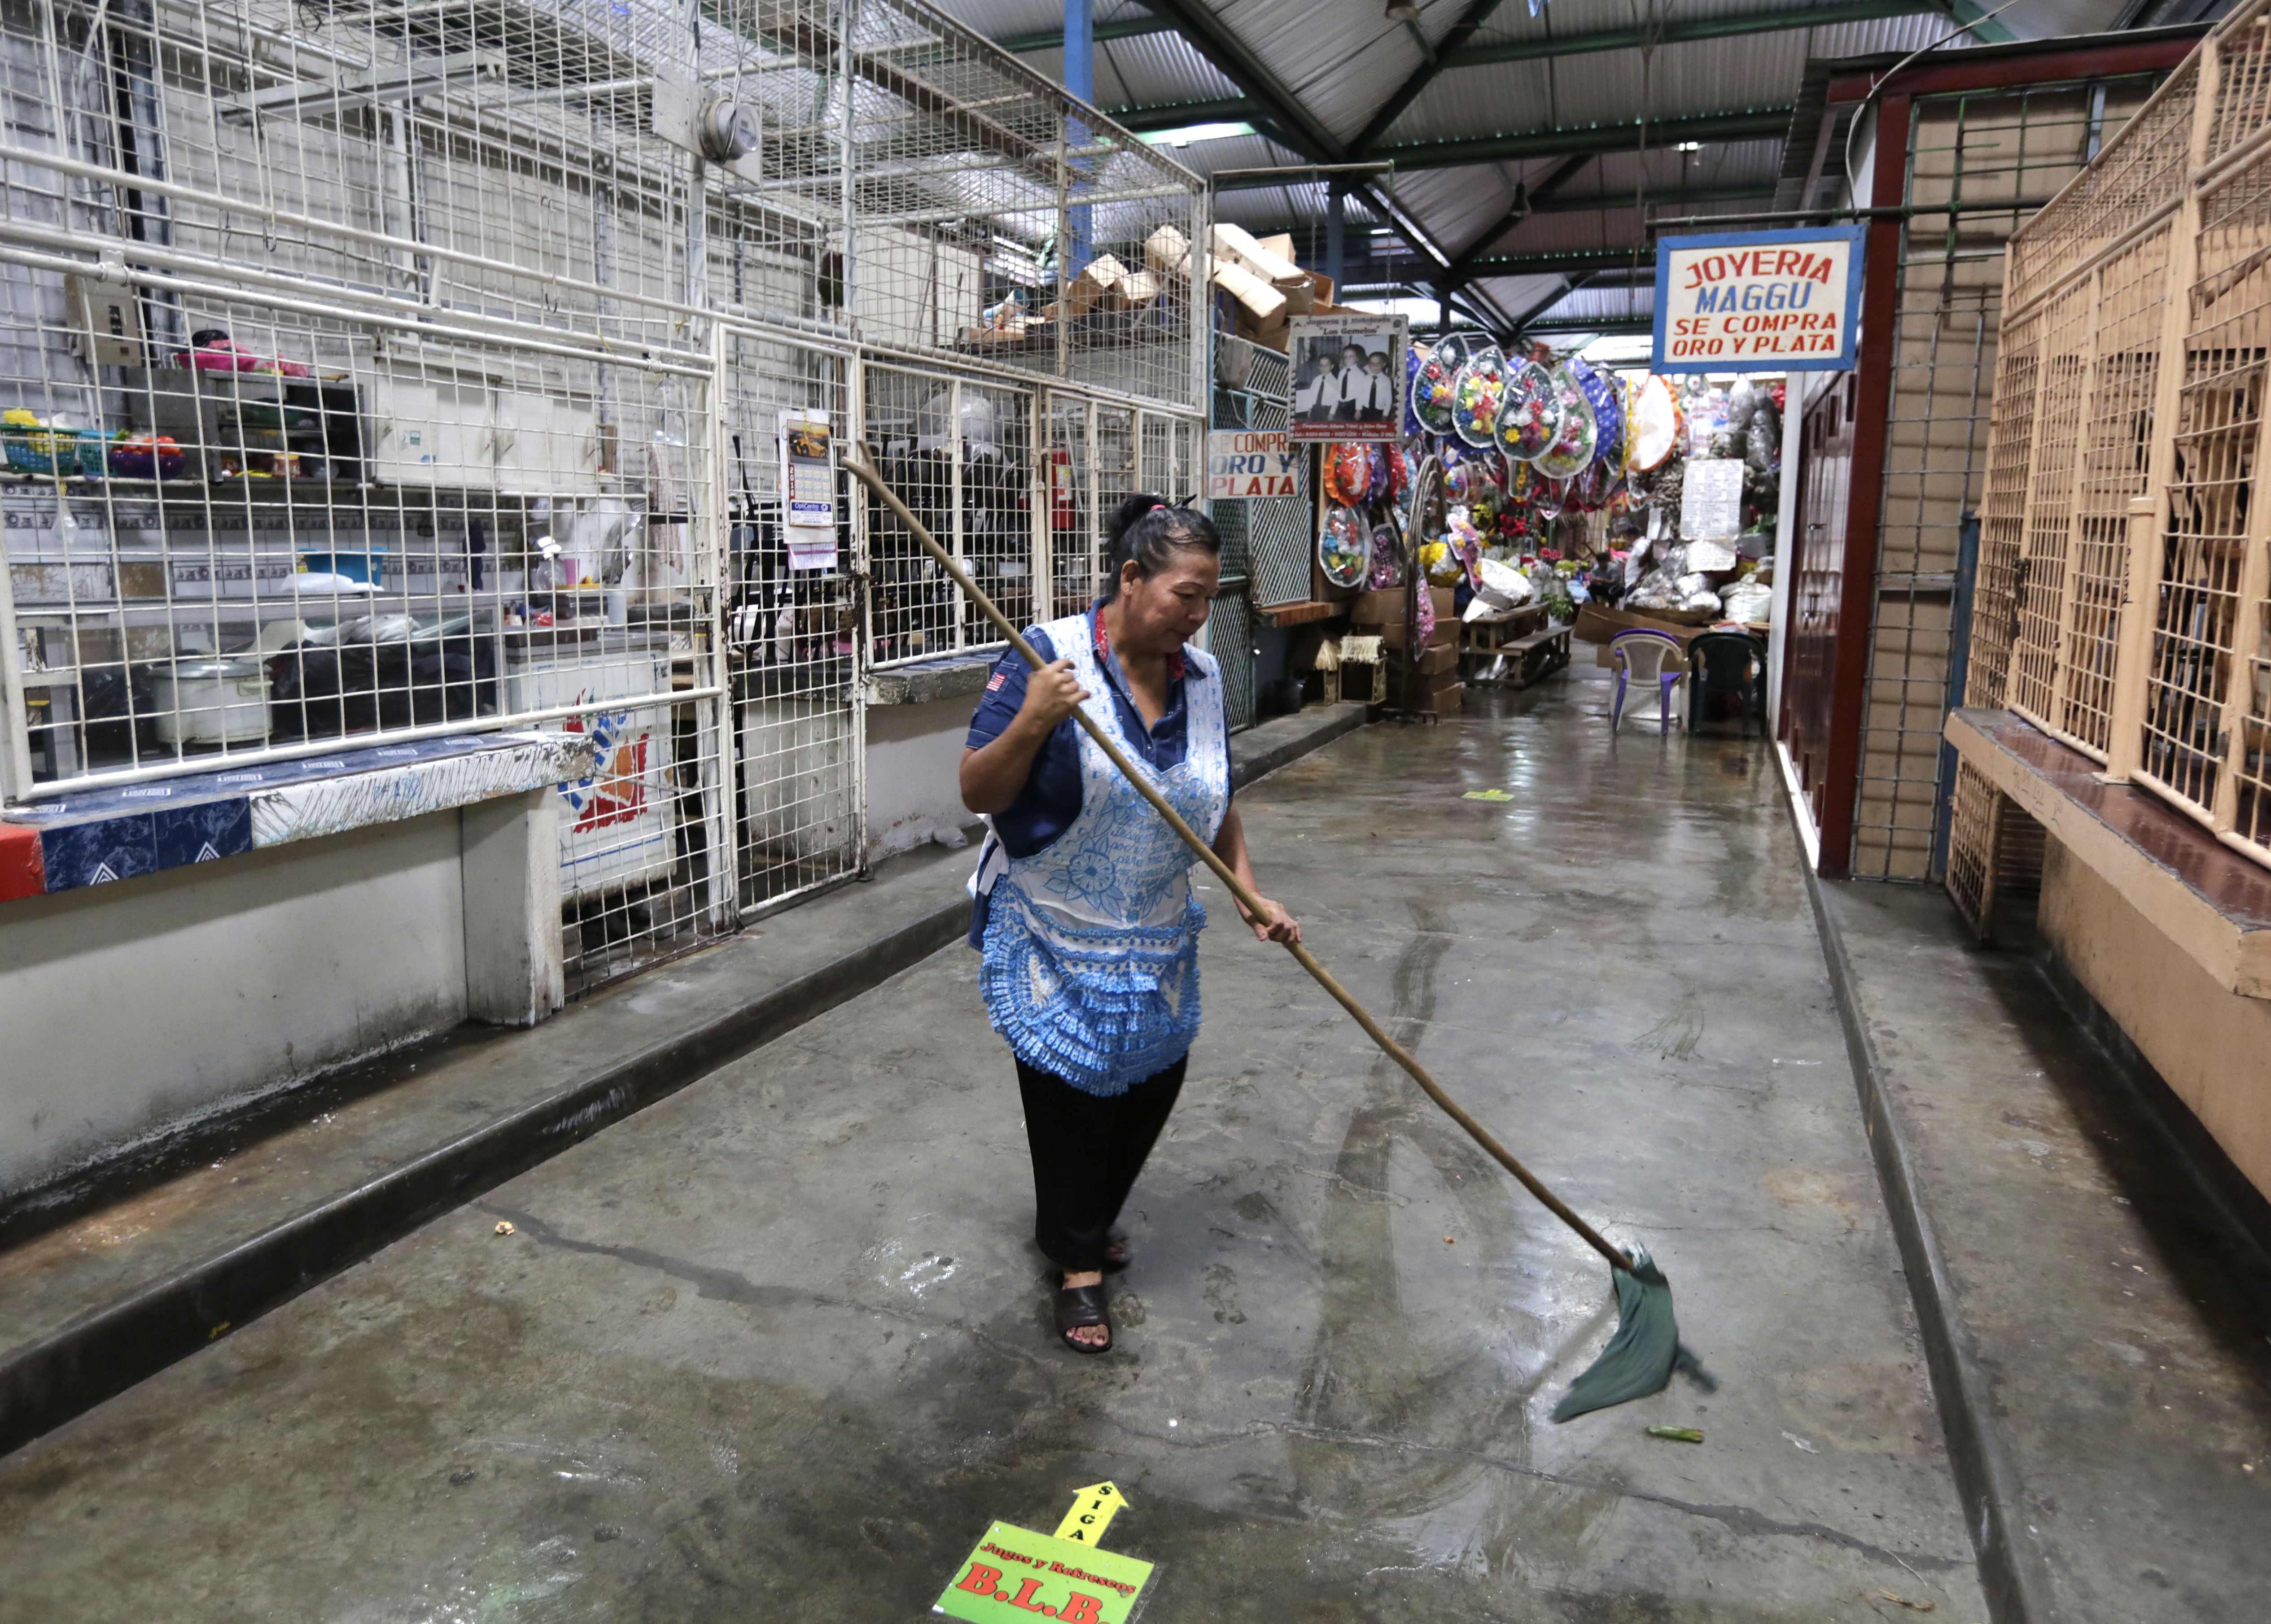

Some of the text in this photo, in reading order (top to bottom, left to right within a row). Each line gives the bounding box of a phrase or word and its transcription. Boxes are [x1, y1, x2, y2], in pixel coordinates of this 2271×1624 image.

[1684, 250, 1833, 289] JOYERIA
[1695, 282, 1812, 314] MAGGU
[1673, 313, 1837, 336] SE COMPRA
[1672, 334, 1835, 357] ORO Y PLATA
[1210, 454, 1295, 475] ORO Y
[1210, 476, 1295, 496] PLATA
[1069, 1485, 1113, 1541] SIGA
[980, 1542, 1136, 1593] Jugos y Refrescos
